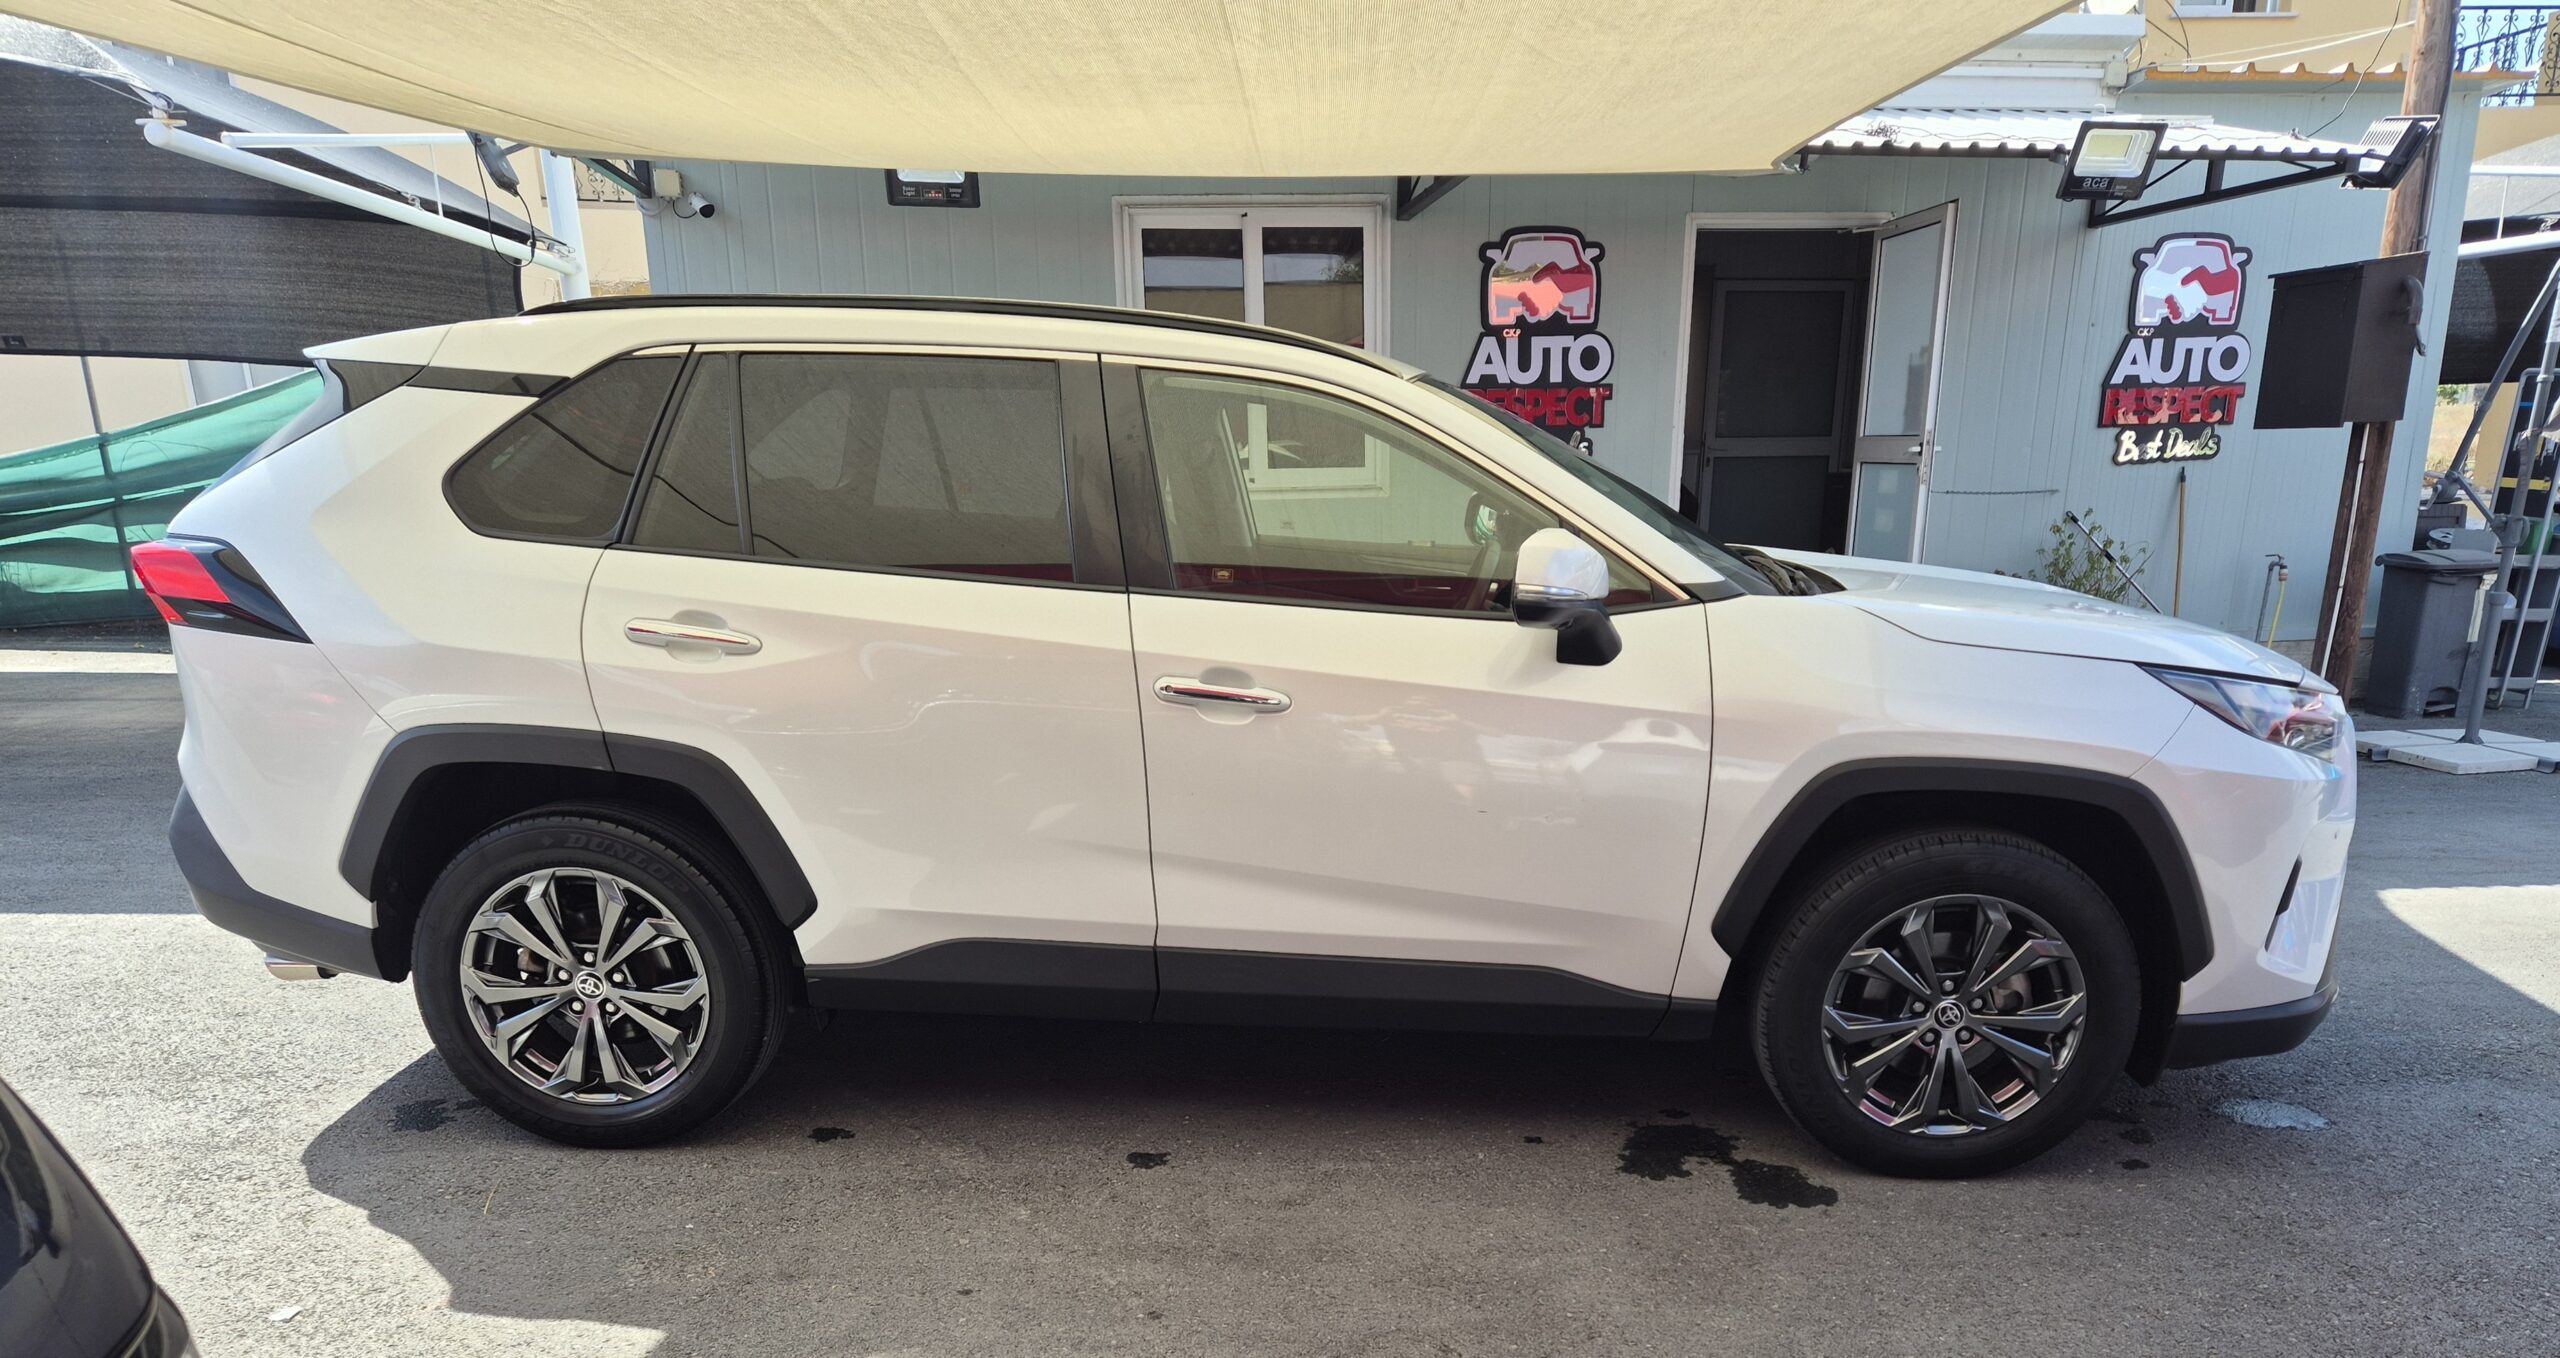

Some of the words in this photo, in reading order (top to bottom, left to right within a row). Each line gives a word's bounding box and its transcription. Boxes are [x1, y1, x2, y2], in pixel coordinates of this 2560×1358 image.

[1466, 334, 1611, 384] AUTO
[2110, 335, 2250, 385] AUTO
[2102, 385, 2245, 425] RESPECT
[2163, 426, 2218, 459] Deals
[563, 833, 691, 893] DUNLOP
